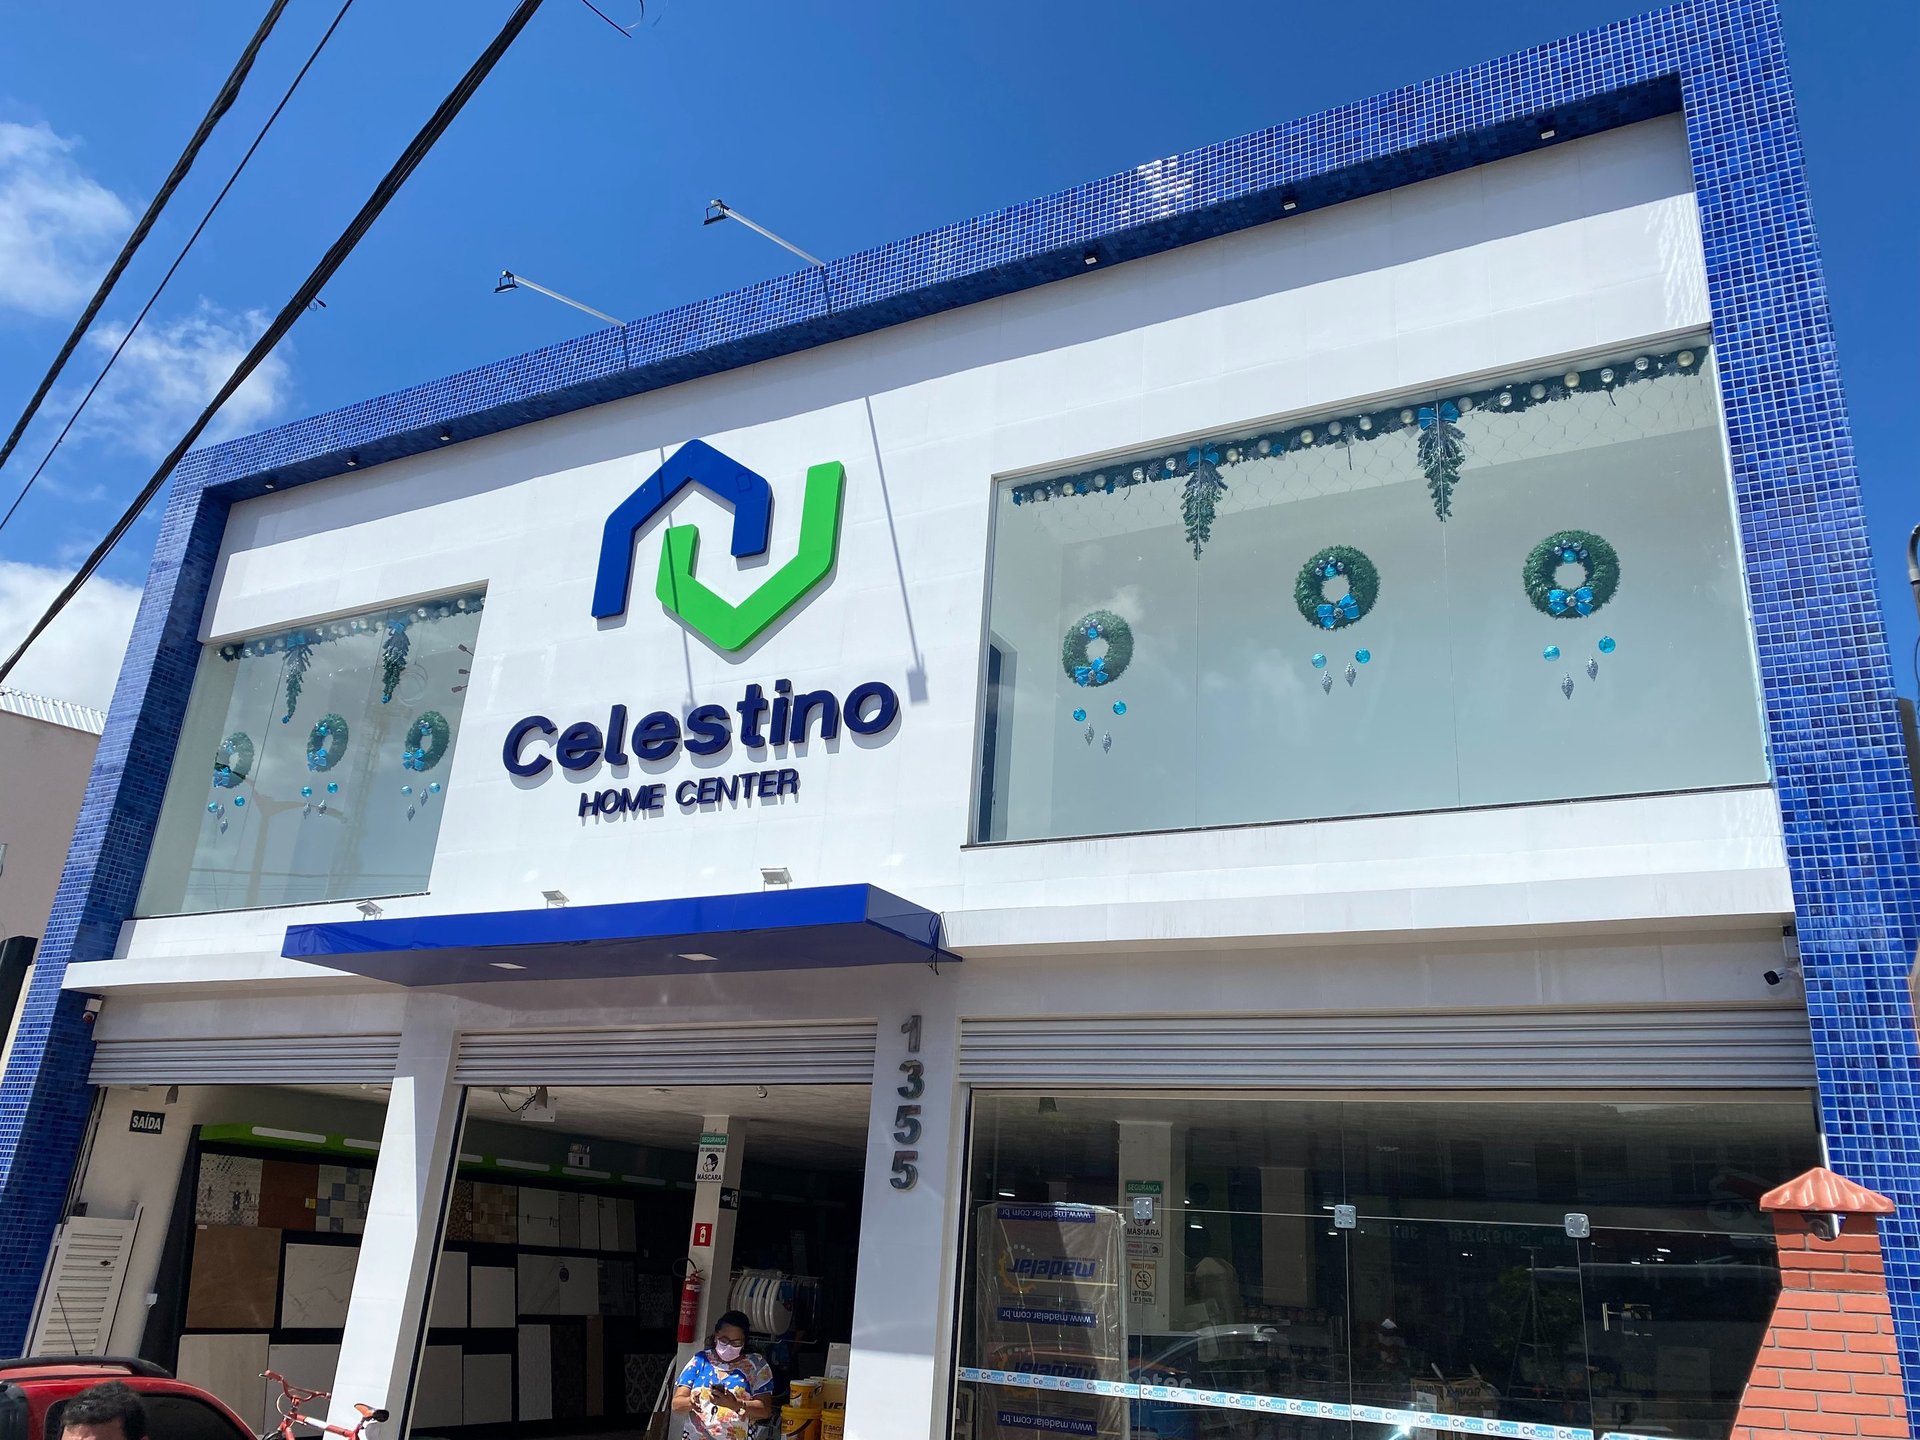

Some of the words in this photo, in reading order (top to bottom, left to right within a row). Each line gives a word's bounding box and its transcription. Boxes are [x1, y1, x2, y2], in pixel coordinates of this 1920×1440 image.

[502, 678, 899, 777] Celestino
[578, 783, 666, 818] HOME
[676, 768, 799, 807] CENTER
[889, 1015, 926, 1190] 1355
[132, 1114, 161, 1130] SAÍDA
[697, 1173, 722, 1181] MÁSCARA
[1127, 1183, 1160, 1193] SEGURANÇA
[1126, 1227, 1160, 1236] MÁSCARA
[1006, 1257, 1096, 1280] madelar
[1001, 1309, 1092, 1324] www.madelar.com.br
[981, 1371, 1004, 1381] Cecon
[1006, 1374, 1030, 1384] Cecon
[1033, 1377, 1056, 1387] Cecon
[1086, 1382, 1111, 1392] Cecon
[1114, 1385, 1138, 1395] Cecon
[1142, 1387, 1168, 1398] Cecon
[1200, 1394, 1226, 1404] Cecon
[1229, 1396, 1256, 1407] Cecon
[1259, 1399, 1286, 1410] Cecon
[1290, 1403, 1317, 1413] Cecon
[1321, 1406, 1349, 1416] Cecon
[1353, 1409, 1382, 1419] Cecon
[1418, 1415, 1448, 1426] Cecon
[1452, 1419, 1483, 1430] Cecon
[1487, 1423, 1518, 1434] Cecon
[1522, 1427, 1554, 1438] Cecon
[1558, 1430, 1592, 1440] Cecon
[1001, 1414, 1092, 1432] www.madelar.com.br
